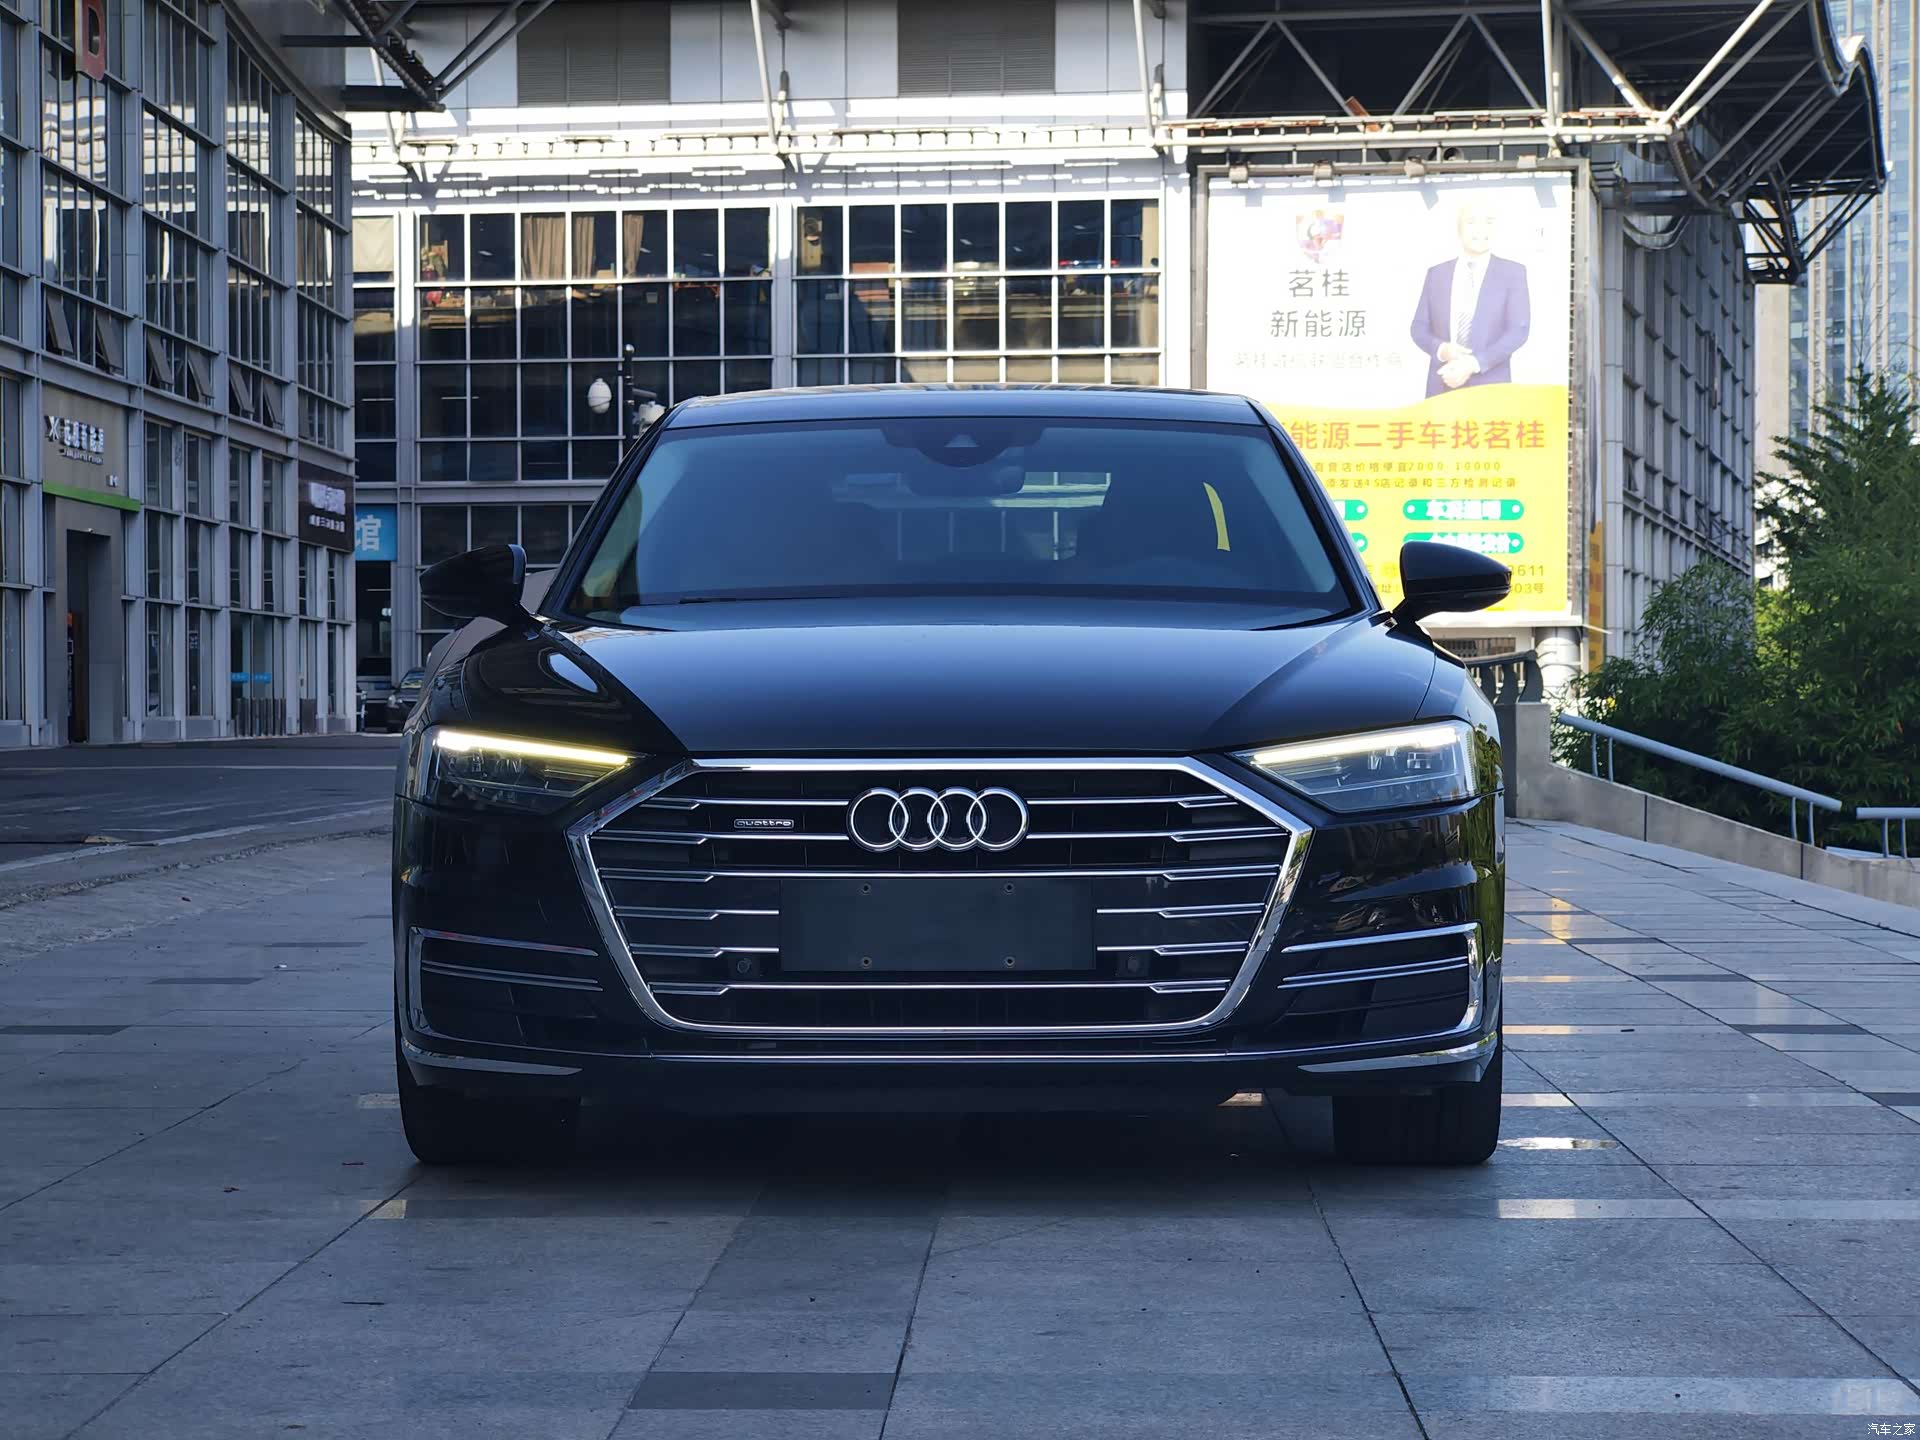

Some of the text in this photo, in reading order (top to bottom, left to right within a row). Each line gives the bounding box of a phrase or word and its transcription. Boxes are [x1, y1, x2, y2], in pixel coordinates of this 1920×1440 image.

[1288, 269, 1350, 297] 茗桂
[1270, 309, 1366, 337] 新能源
[1282, 420, 1545, 449] 能源二手车找茗桂
[356, 514, 382, 551] 馆
[1510, 582, 1545, 594] 03号
[736, 820, 791, 828] quattro
